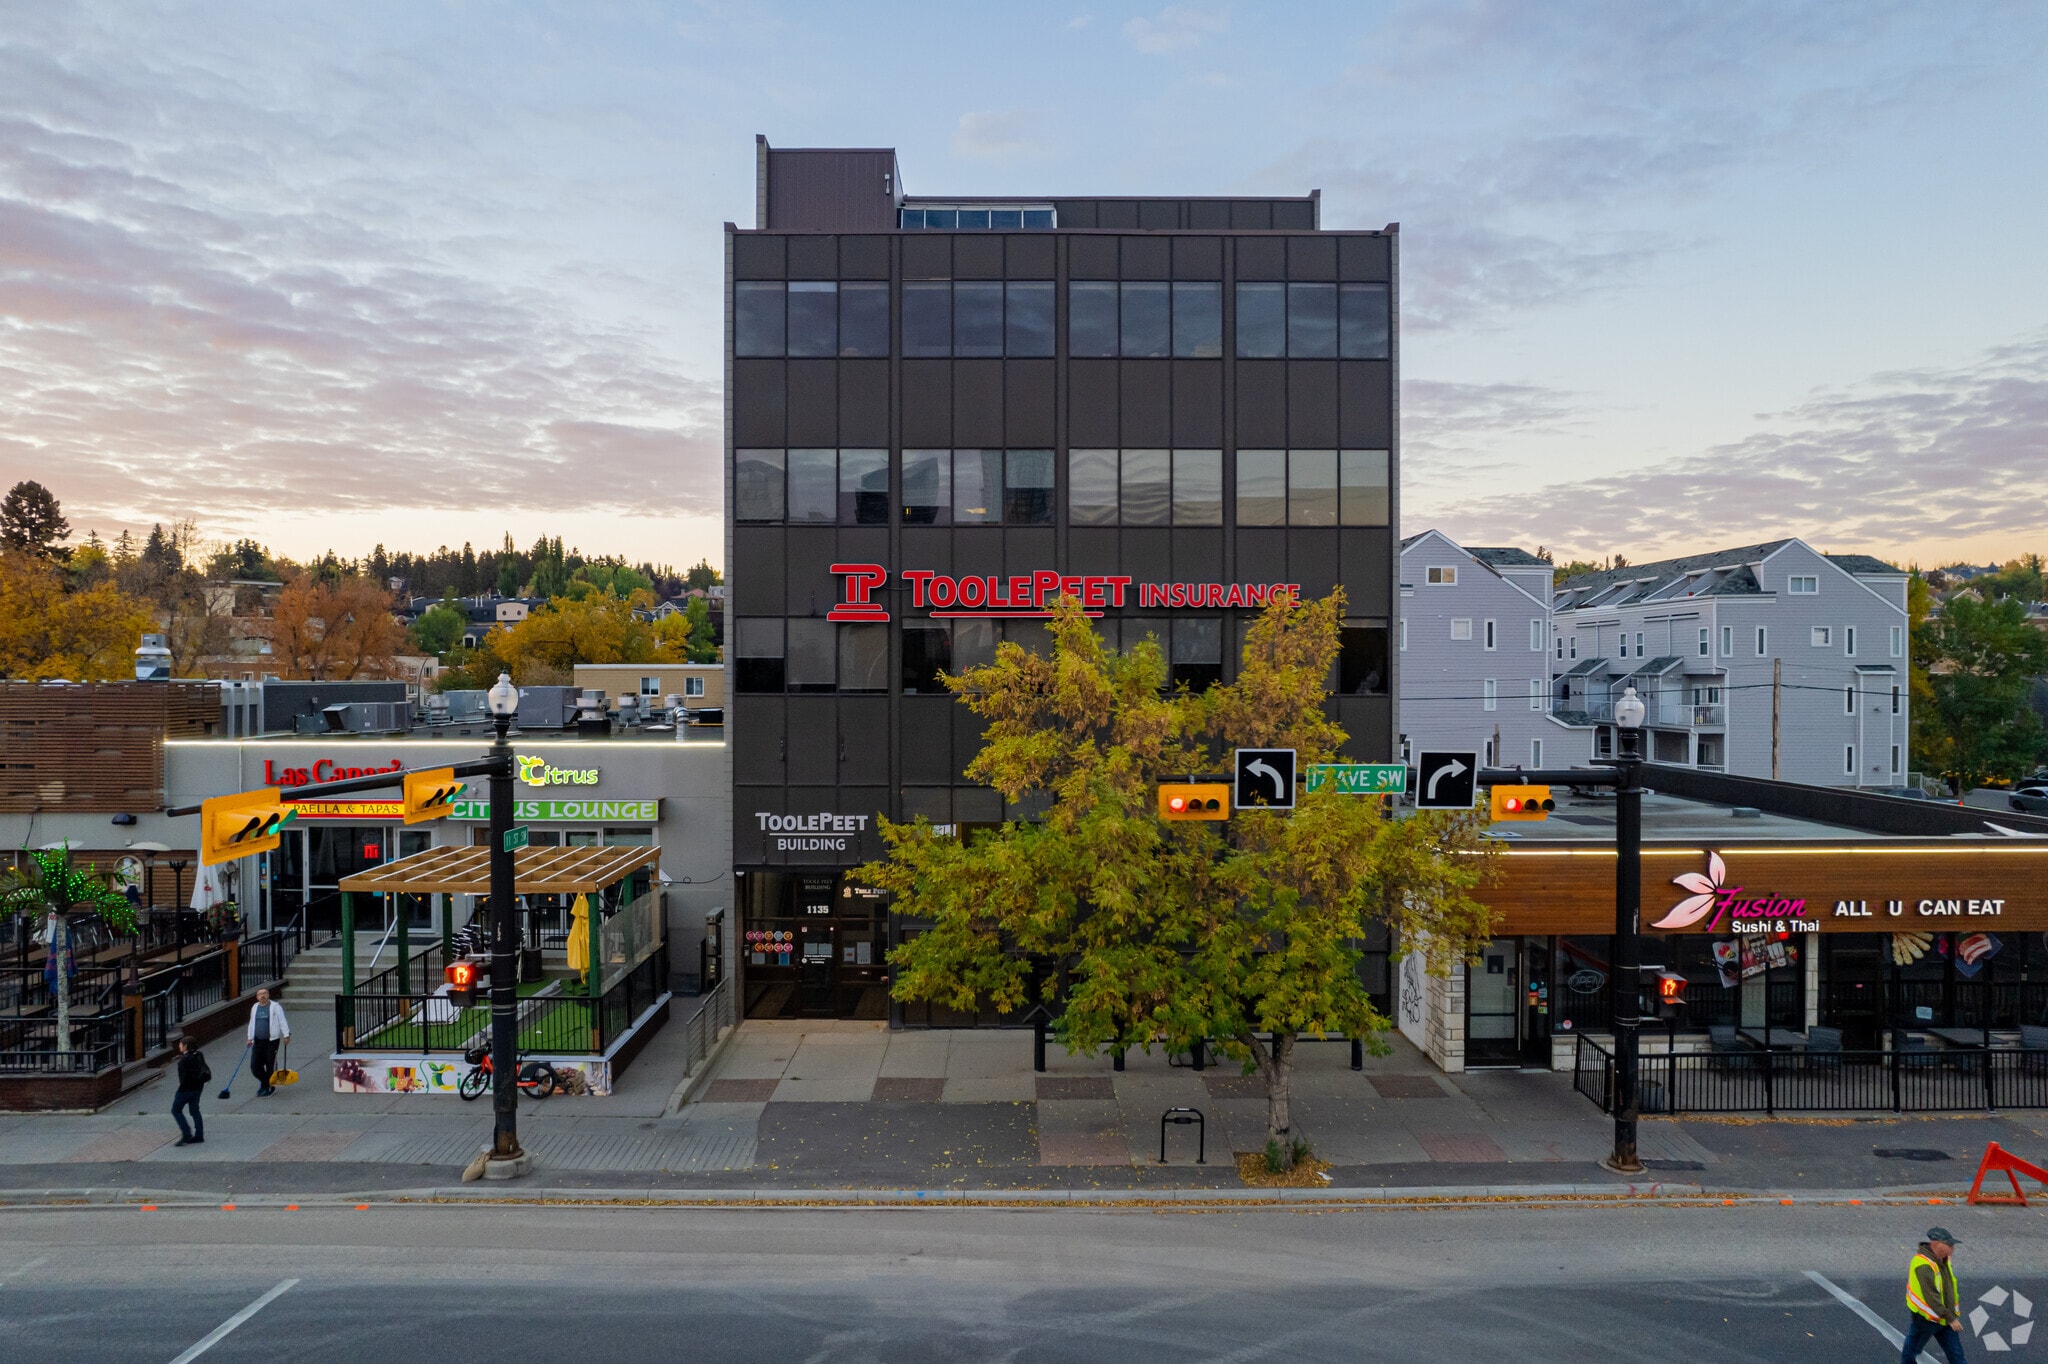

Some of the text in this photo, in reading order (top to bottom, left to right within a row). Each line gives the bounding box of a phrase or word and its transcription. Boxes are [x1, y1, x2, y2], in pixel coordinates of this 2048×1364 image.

[1139, 583, 1301, 608] INSURANCE
[264, 759, 309, 787] Las
[517, 756, 599, 786] Citrus
[1337, 770, 1370, 787] AVE
[1376, 770, 1403, 787] SW
[293, 804, 399, 814] PAELLA & TAPAS
[452, 802, 654, 819] CITUS LOUNGE
[777, 838, 846, 851] BUILDING
[806, 904, 829, 914] 1135
[1707, 886, 1807, 932] Fusion
[1835, 899, 2006, 917] ALL U CAN EAT
[1731, 919, 1820, 933] Sushi & Thai
[1570, 975, 1602, 988] OPEN
